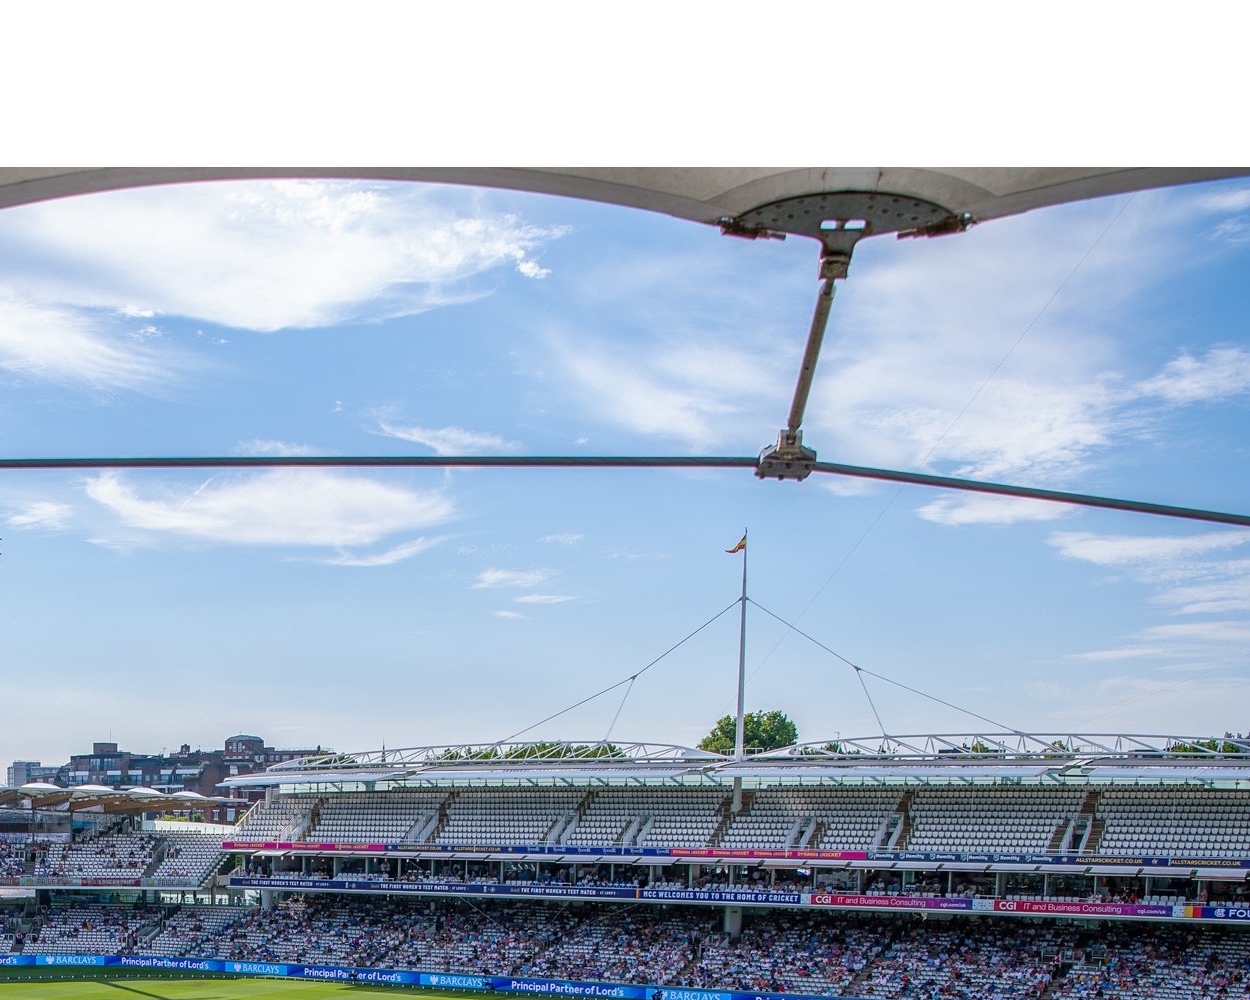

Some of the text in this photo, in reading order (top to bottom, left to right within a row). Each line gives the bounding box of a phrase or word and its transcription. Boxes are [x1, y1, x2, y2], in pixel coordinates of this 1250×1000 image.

[816, 896, 831, 904] CGI
[891, 898, 926, 907] Consulting
[999, 902, 1016, 910] CGI
[1082, 905, 1122, 914] Consulting
[122, 957, 151, 966] Principal
[153, 958, 178, 968] Partner
[188, 960, 208, 969] Lord's
[304, 968, 336, 978] Principal
[367, 972, 376, 980] of
[377, 972, 401, 981] Lord's
[440, 976, 482, 987] BARCLAYS
[512, 981, 624, 996] Principal Partner of Lord's
